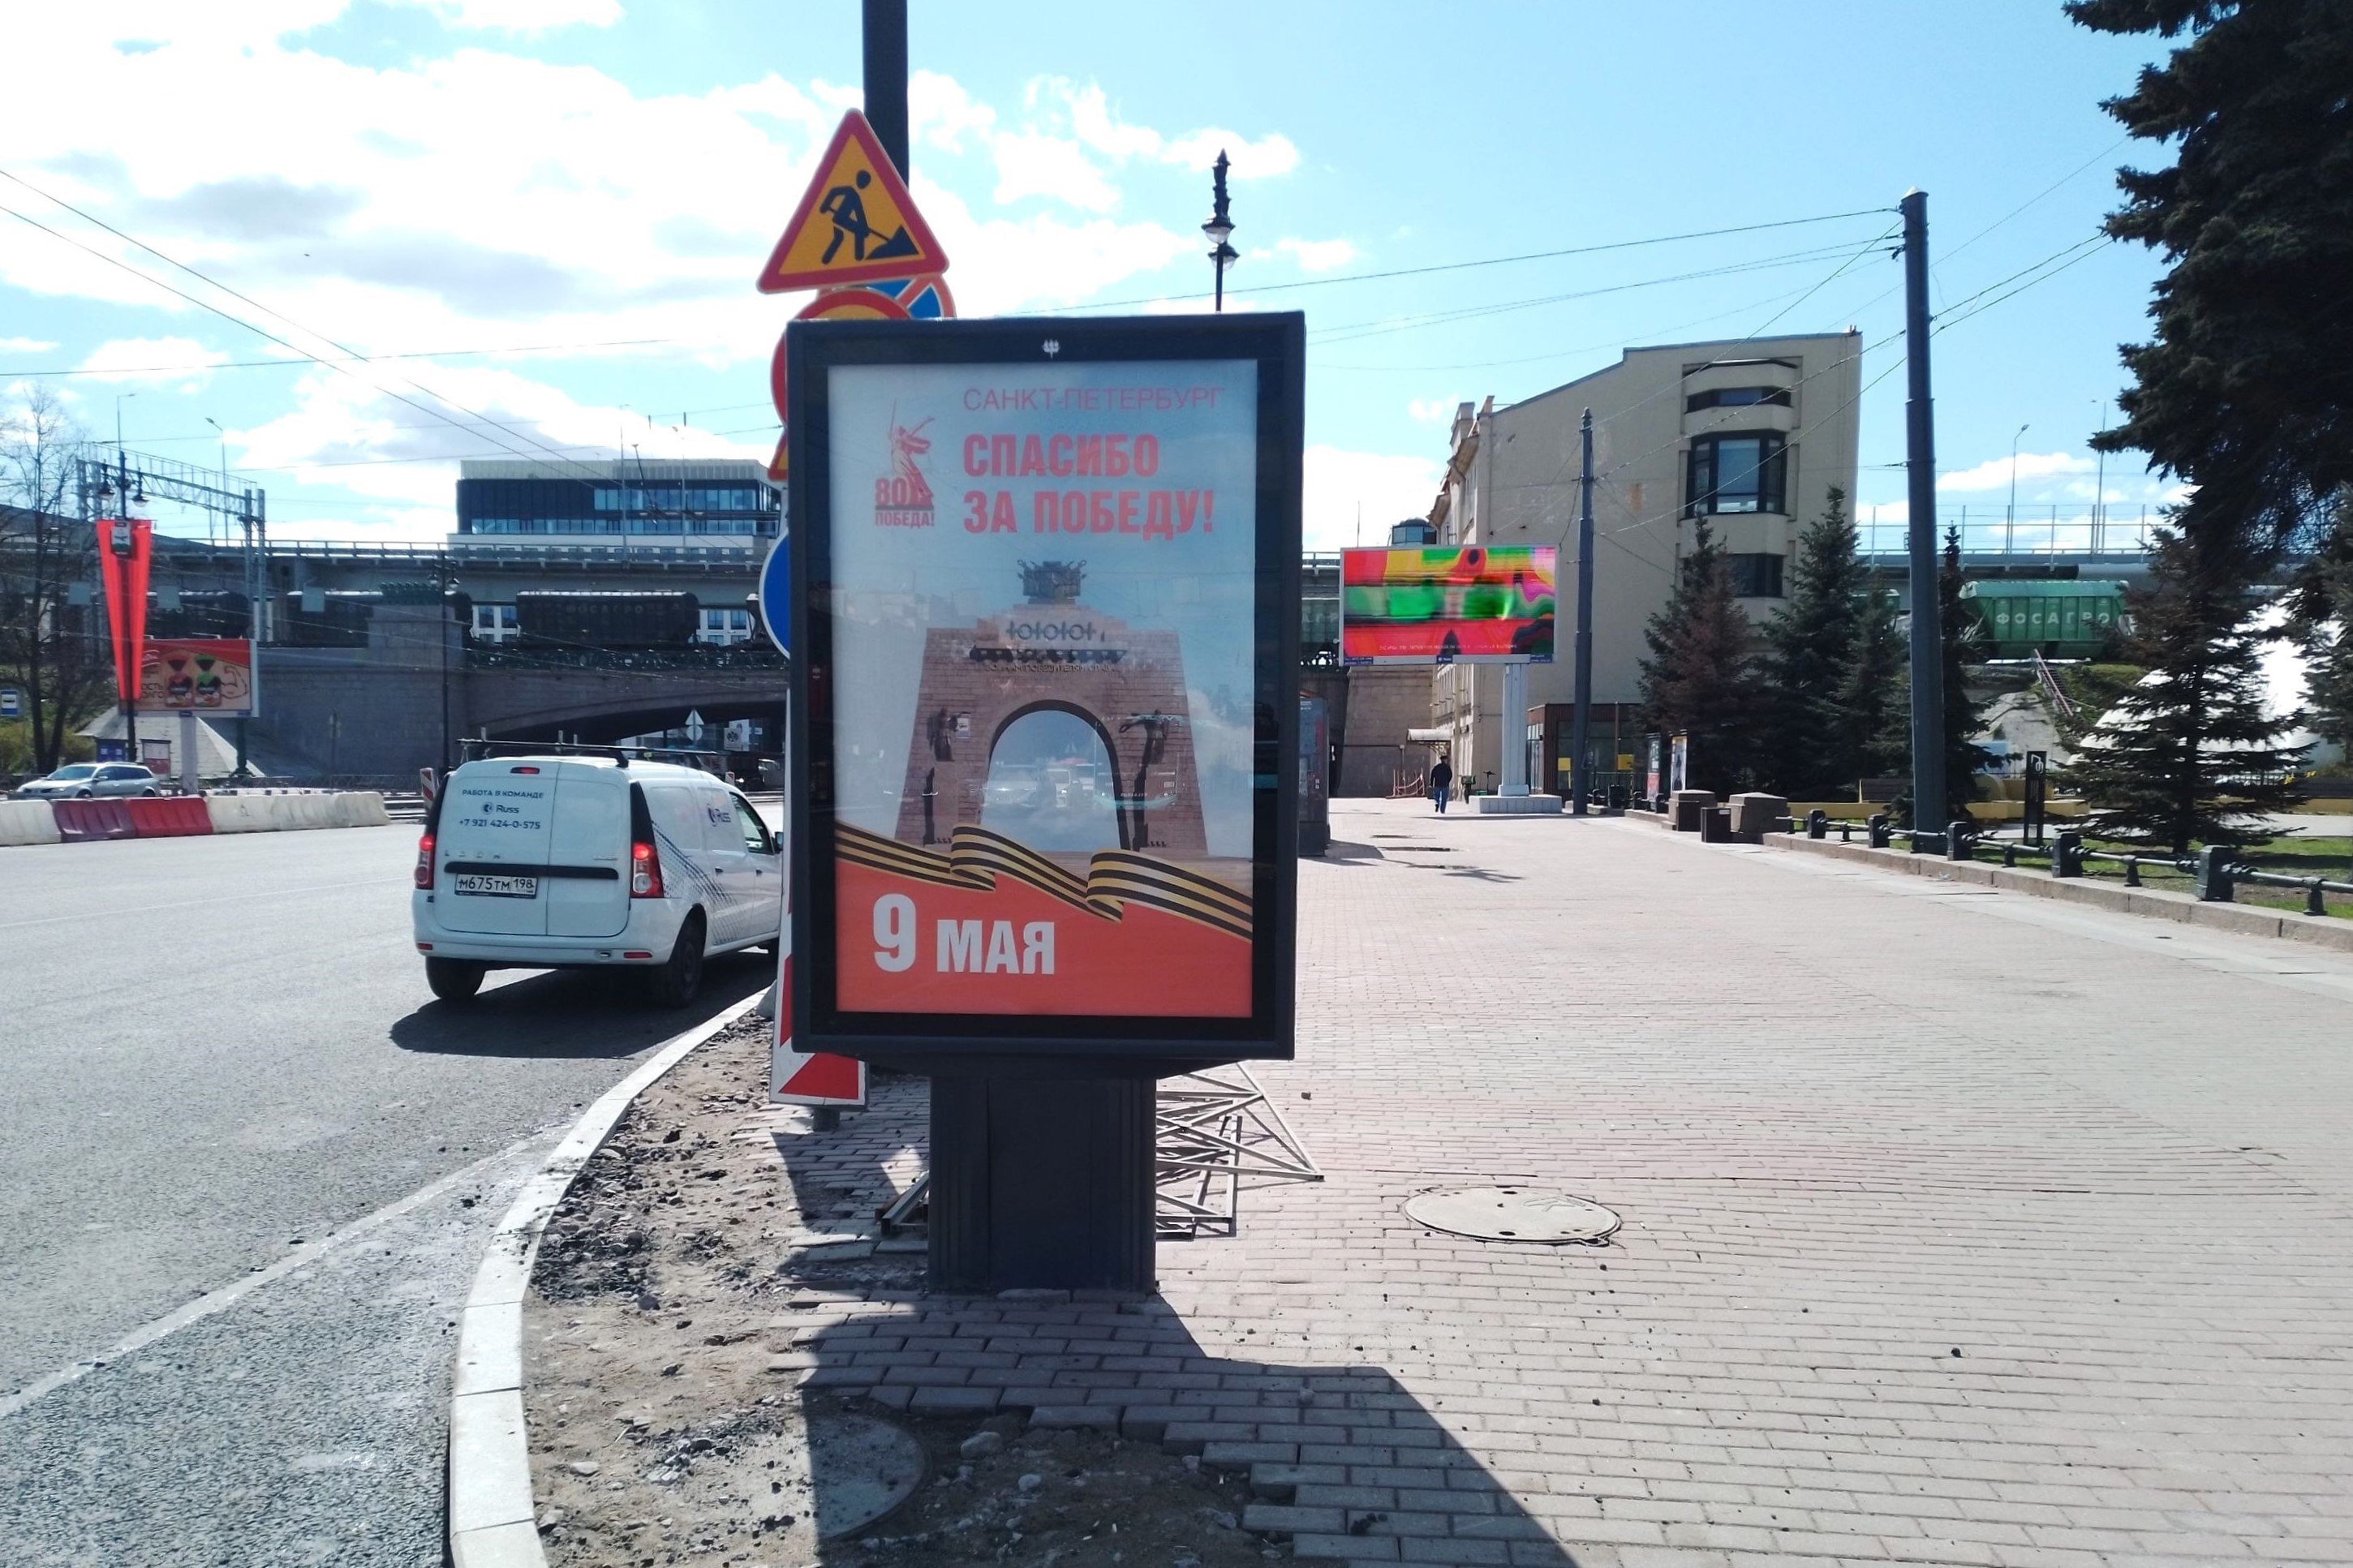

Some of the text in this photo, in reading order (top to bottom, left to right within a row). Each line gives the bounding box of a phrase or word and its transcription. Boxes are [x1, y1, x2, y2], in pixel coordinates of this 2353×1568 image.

[963, 387, 1225, 412] САНКТ-ПЕТЕРБУРГ
[963, 433, 1159, 477] СПАСИБО
[875, 477, 909, 505] 80
[875, 511, 935, 529] ПОБЕДА!
[963, 490, 1215, 541] ЗА ПОБЕДУ!
[1996, 612, 2110, 625] ФОСАГРО
[502, 791, 544, 799] КОМАНДЕ
[496, 804, 519, 814] Russ
[458, 818, 541, 830] +7 921 424-0-575
[458, 877, 511, 891] М675ТМ
[873, 893, 1055, 974] 9 МАЯ
